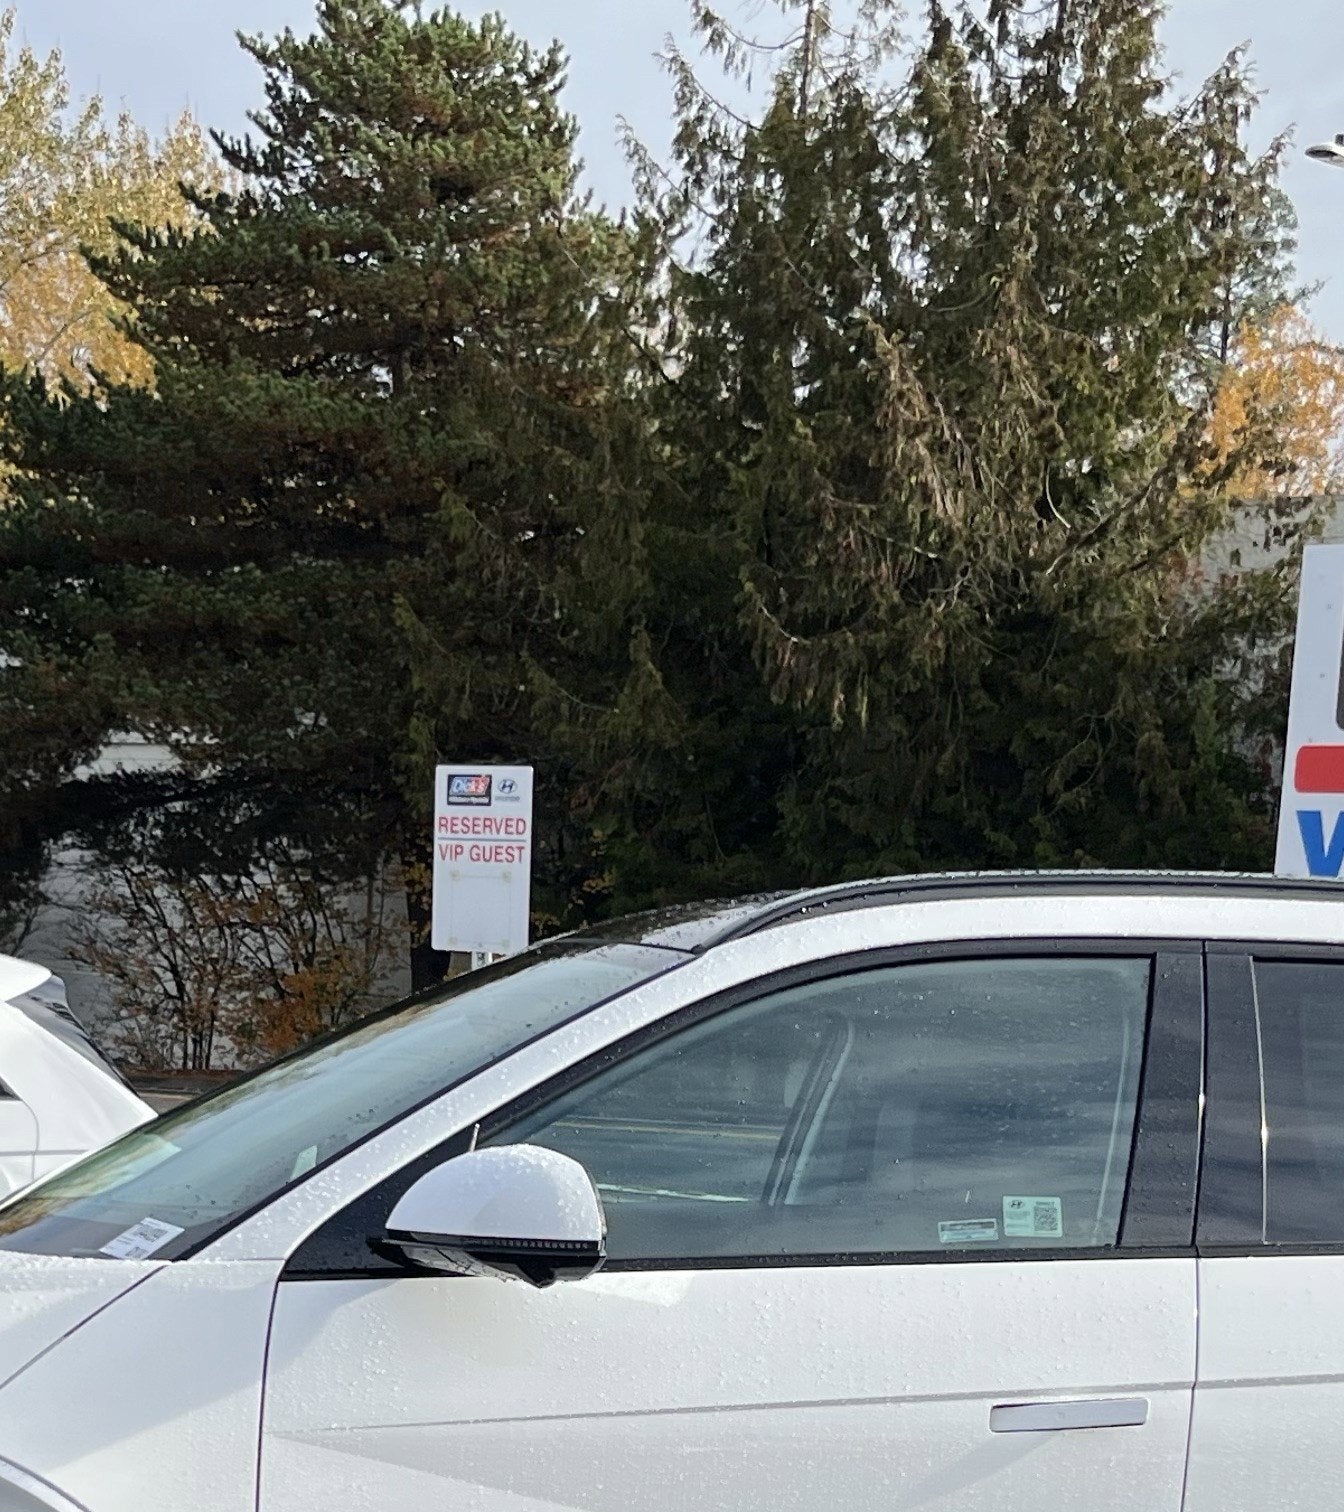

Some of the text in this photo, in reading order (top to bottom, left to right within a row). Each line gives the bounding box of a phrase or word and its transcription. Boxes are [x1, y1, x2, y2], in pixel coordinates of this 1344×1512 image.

[438, 816, 526, 836] RESERVED
[438, 843, 525, 864] VIP GUEST
